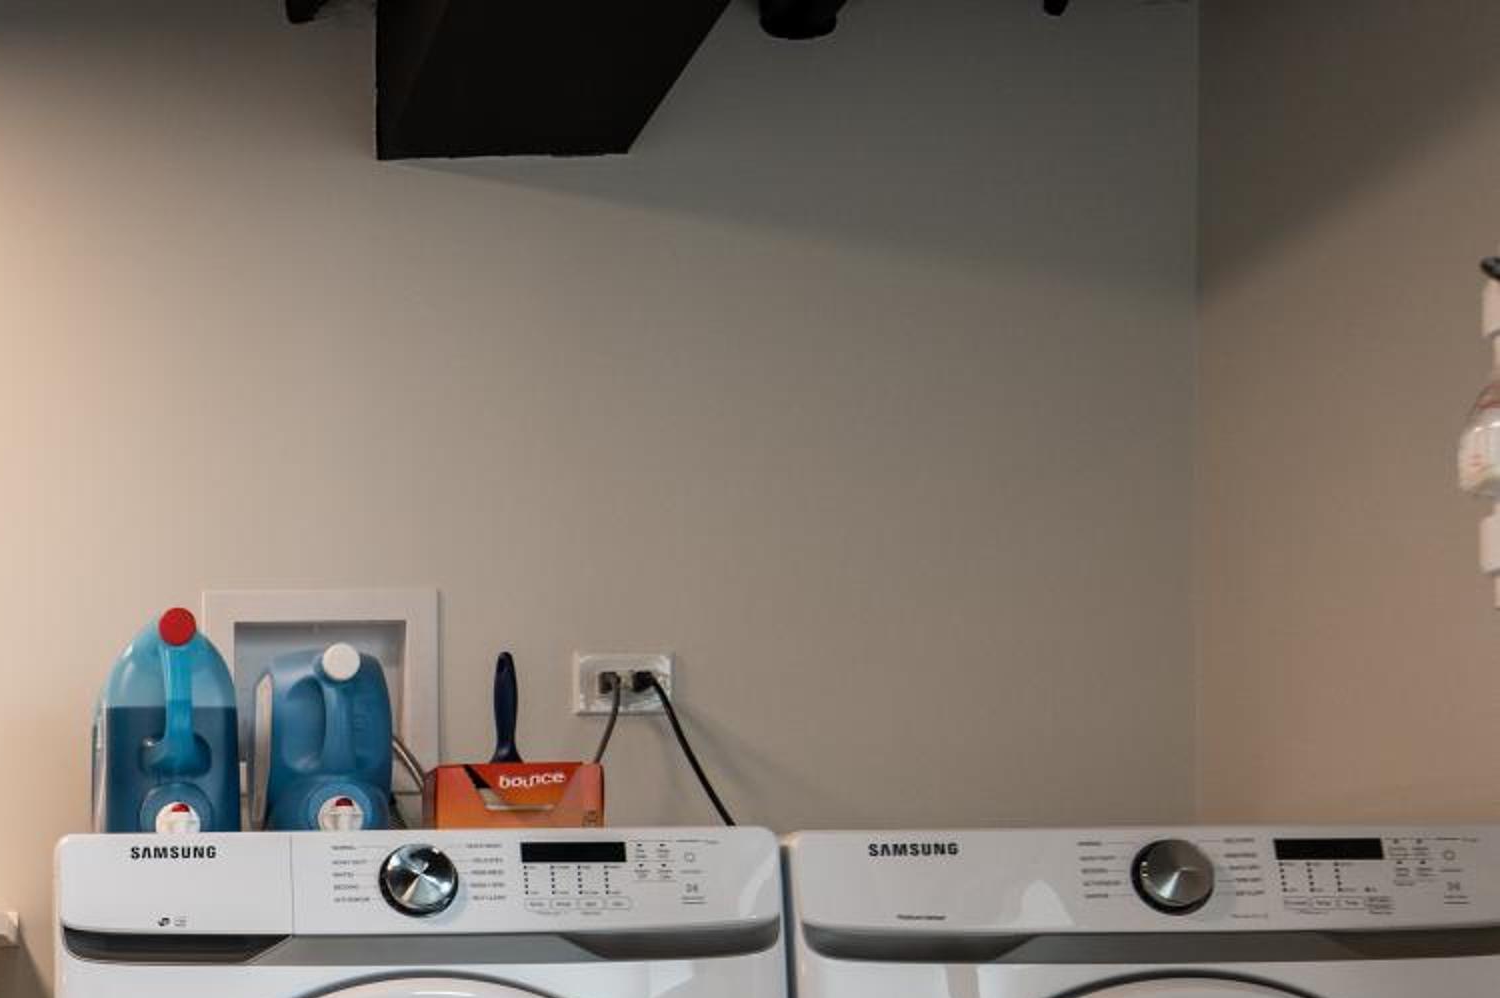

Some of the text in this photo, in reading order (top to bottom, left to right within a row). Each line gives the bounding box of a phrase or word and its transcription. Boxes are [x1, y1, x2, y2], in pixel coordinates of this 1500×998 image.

[499, 771, 566, 789] bounce
[130, 845, 217, 860] SAMSUNG
[868, 842, 959, 857] SAMSUNG
